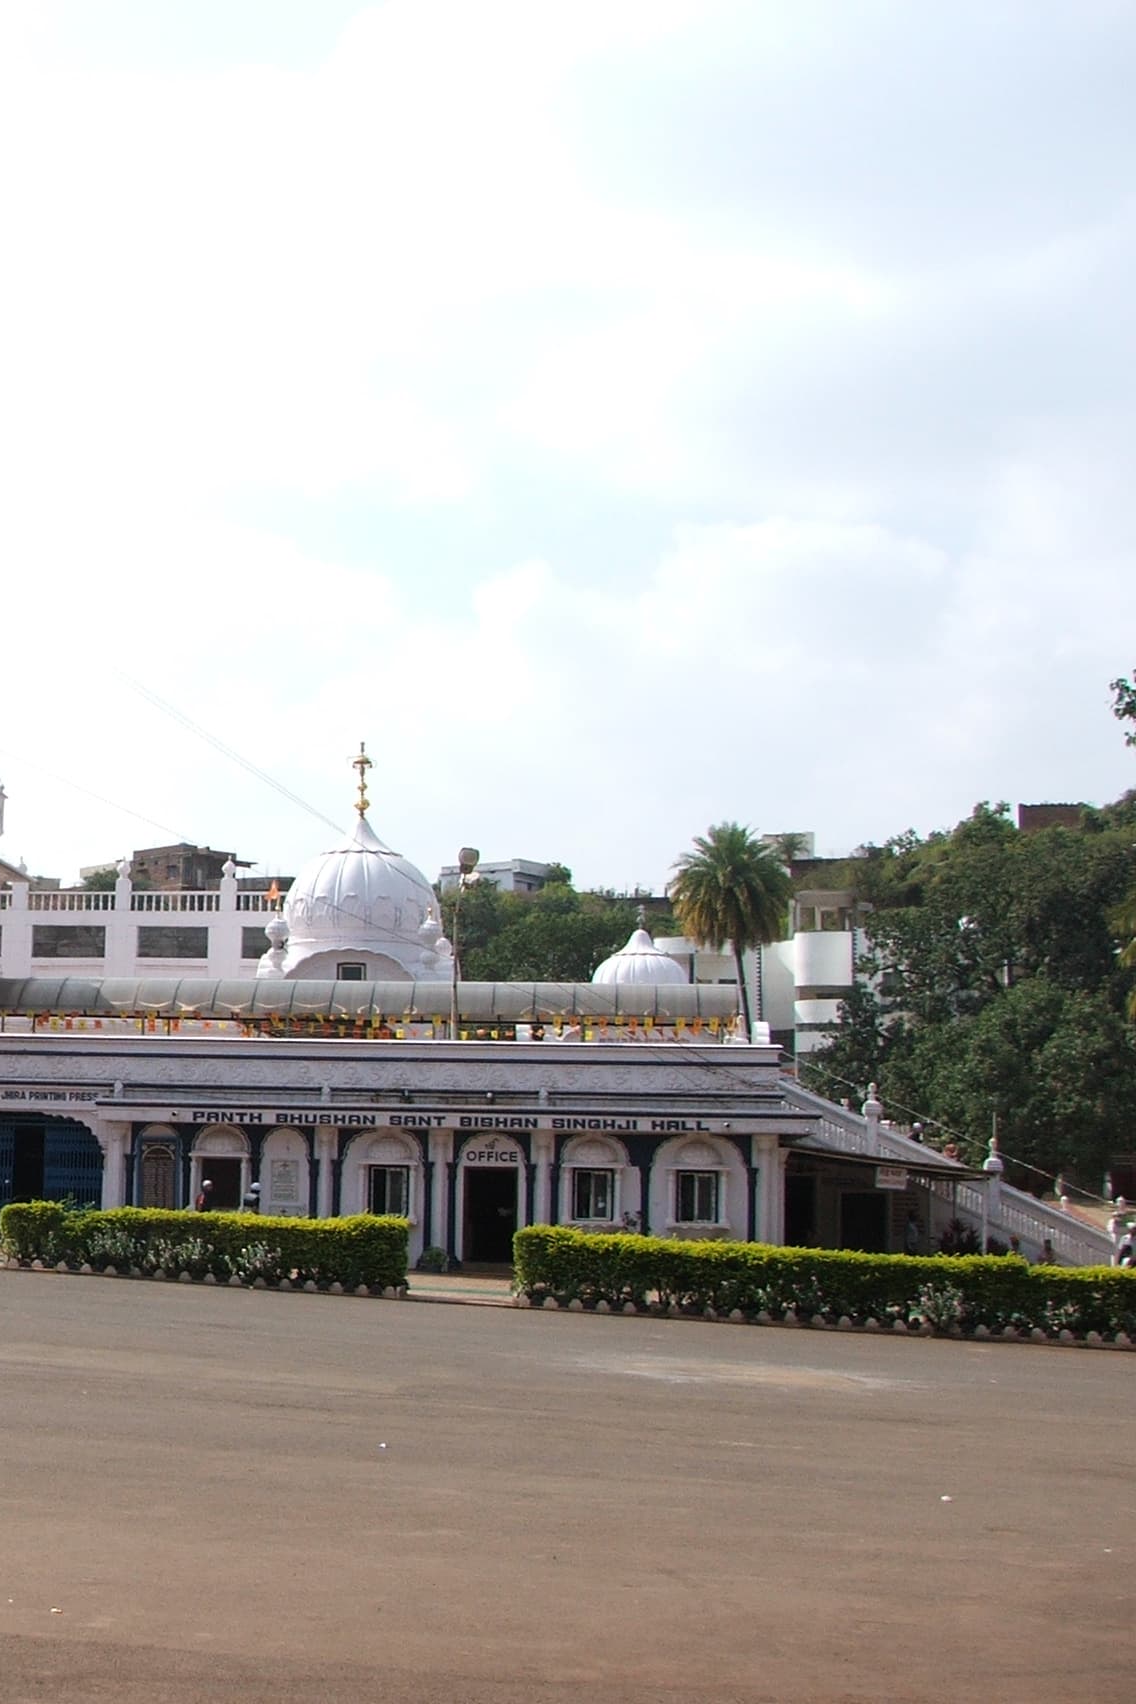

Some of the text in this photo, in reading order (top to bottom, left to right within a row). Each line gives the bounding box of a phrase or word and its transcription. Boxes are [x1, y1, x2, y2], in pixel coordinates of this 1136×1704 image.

[28, 1091, 67, 1101] PRINTING
[69, 1092, 99, 1102] PRESS
[192, 1111, 710, 1132] PANTH BHUSHAN SANT BISHAN SINGHJI HALL
[466, 1150, 518, 1163] OFFICE
